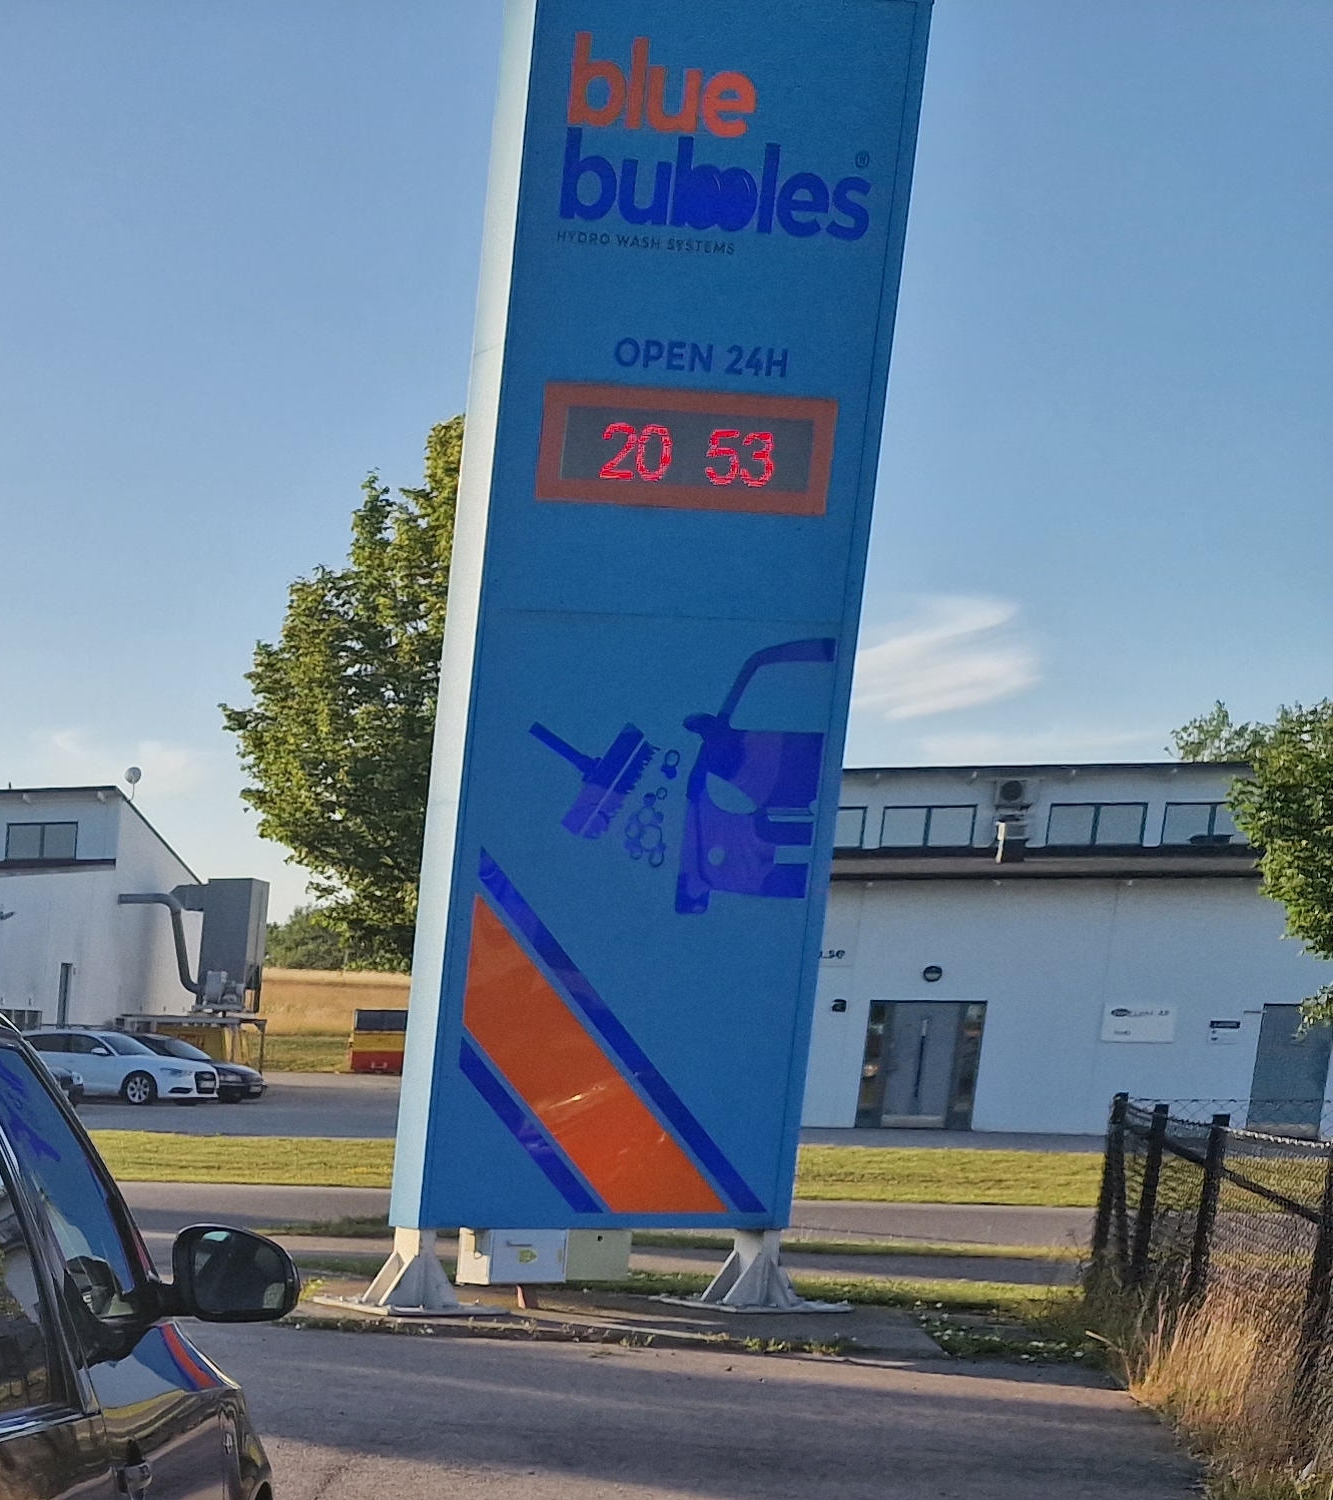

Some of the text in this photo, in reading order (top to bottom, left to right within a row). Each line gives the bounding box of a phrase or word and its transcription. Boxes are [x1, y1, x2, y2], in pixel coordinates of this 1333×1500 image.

[567, 32, 757, 138] blue
[559, 127, 873, 241] bubbles
[556, 230, 735, 256] HYDRO WASH SYSTEMS
[614, 336, 789, 378] OPEN 24H
[598, 422, 775, 489] 20 53
